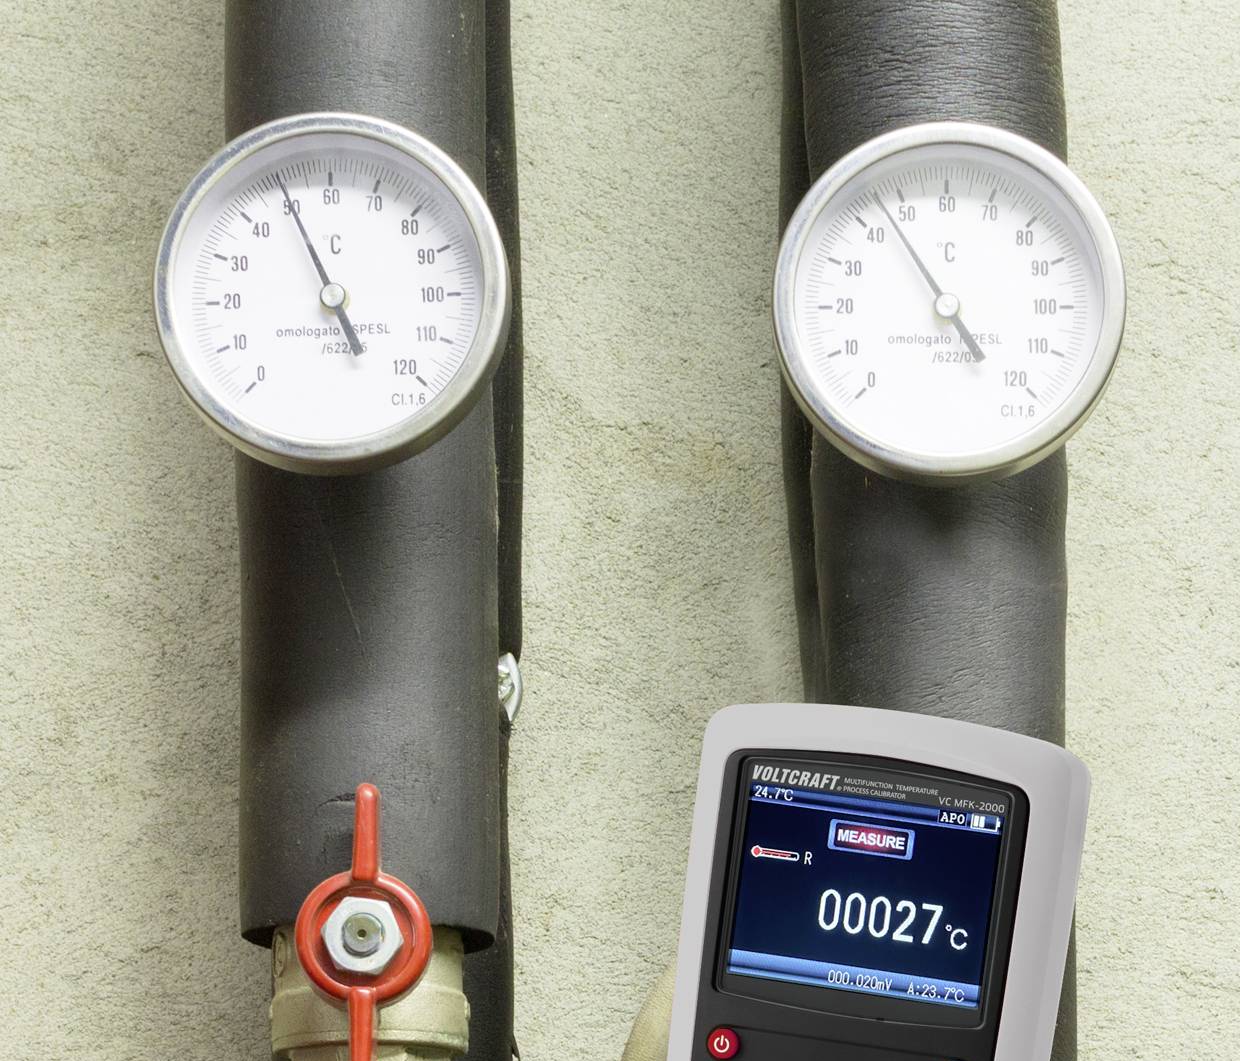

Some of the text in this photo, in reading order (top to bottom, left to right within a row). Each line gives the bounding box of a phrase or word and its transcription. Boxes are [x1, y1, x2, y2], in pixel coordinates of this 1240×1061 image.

[322, 189, 340, 205] 60
[366, 195, 382, 212] 70
[938, 196, 956, 212] 60
[283, 200, 300, 216] 50
[898, 206, 916, 222] 50
[982, 205, 998, 221] 70
[252, 222, 270, 238] 40
[401, 219, 418, 236] 80
[866, 227, 884, 243] 40
[1016, 230, 1034, 246] 80
[231, 256, 248, 272] 30
[417, 249, 435, 265] 90
[844, 260, 862, 276] 30
[1032, 260, 1048, 276] 90
[224, 294, 241, 310] 20
[422, 287, 444, 303] 100
[836, 298, 853, 315] 20
[1034, 299, 1056, 315] 100
[276, 324, 391, 338] omologato SPESL
[416, 326, 436, 342] 110
[233, 335, 247, 350] 10
[844, 340, 858, 356] 10
[888, 334, 952, 346] omologato
[1028, 338, 1048, 354] 110
[932, 352, 978, 364] /622/0
[257, 366, 265, 382] 0
[393, 360, 417, 376] 120
[867, 372, 876, 388] 0
[1004, 371, 1027, 387] 120
[752, 764, 840, 791] VOLTCRAFT
[842, 785, 906, 800] PROCESS CALIBRATOR
[844, 777, 939, 796] MULTIFUNCTION TEMPERATURE
[938, 796, 1006, 814] VC MFK-2000
[940, 811, 966, 825] APO
[837, 828, 906, 851] MEASURE
[804, 852, 813, 866] R
[818, 888, 944, 946] 00027
